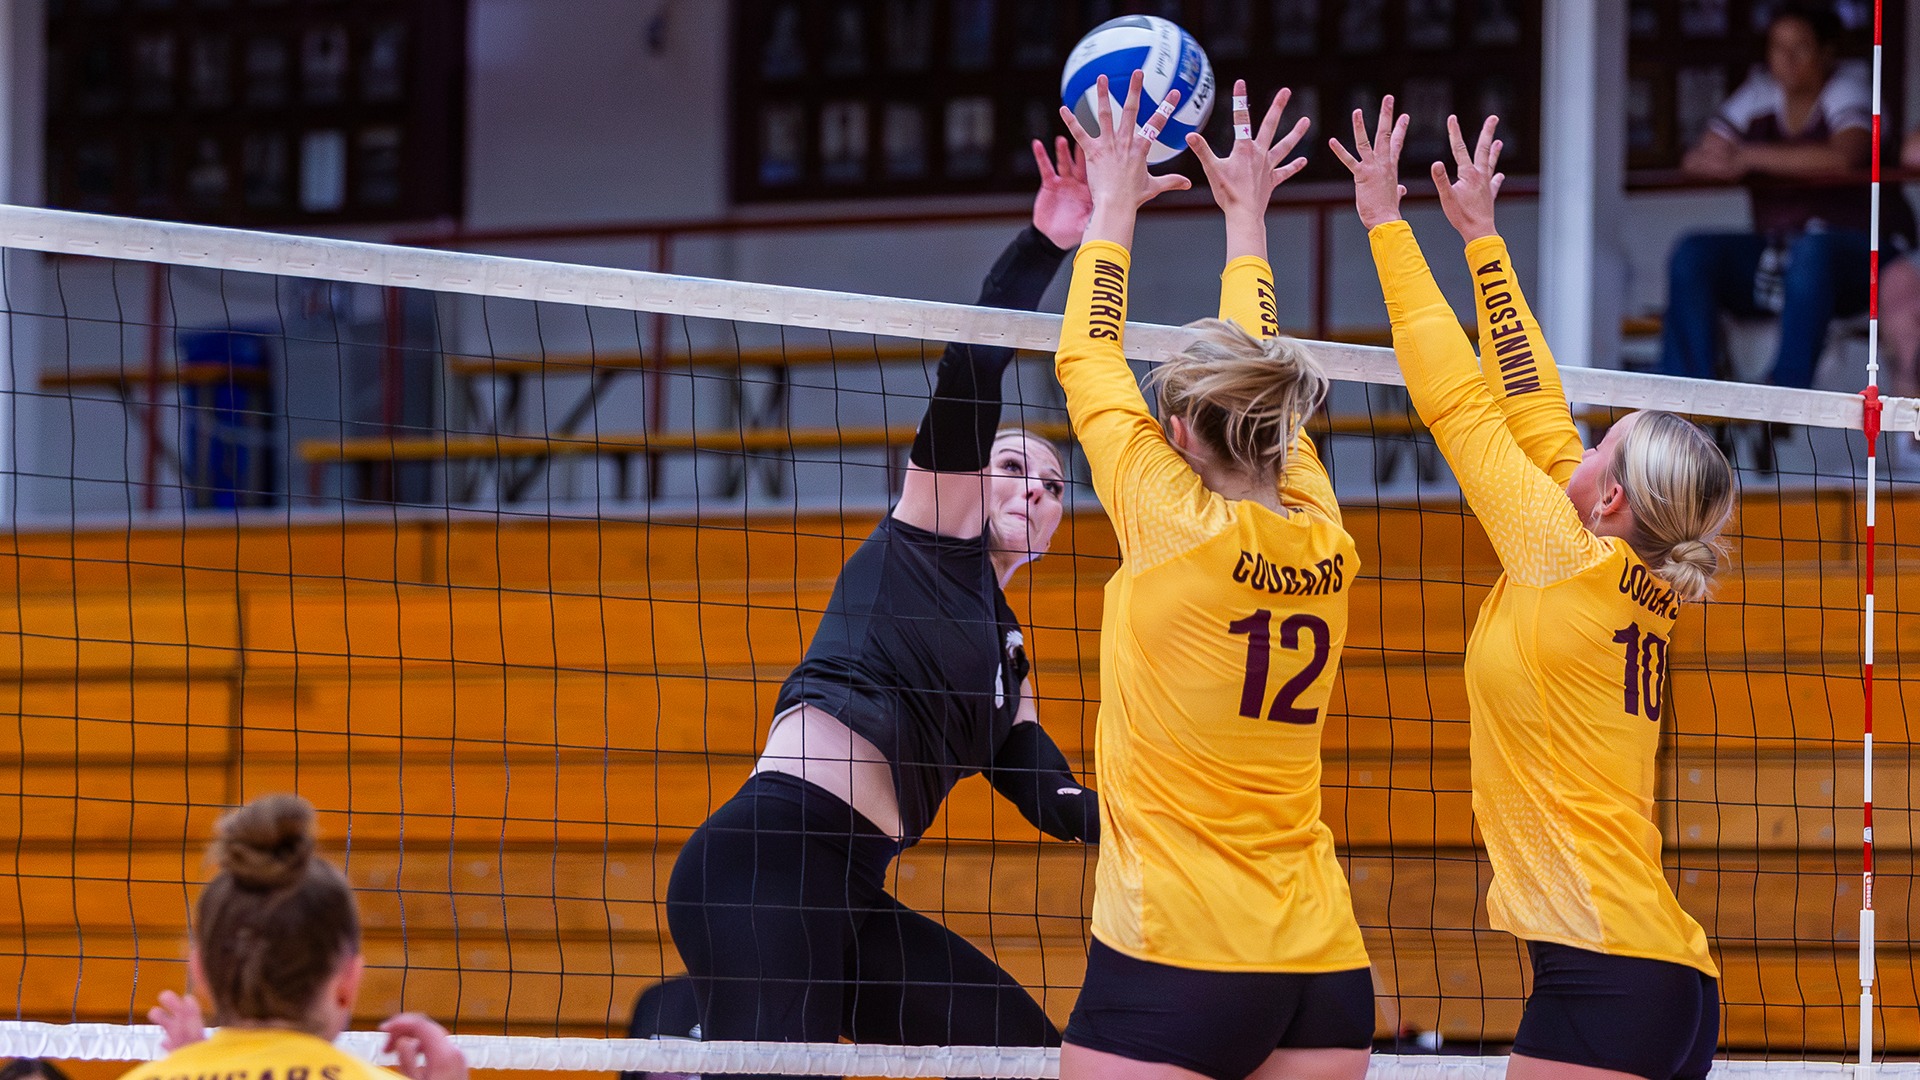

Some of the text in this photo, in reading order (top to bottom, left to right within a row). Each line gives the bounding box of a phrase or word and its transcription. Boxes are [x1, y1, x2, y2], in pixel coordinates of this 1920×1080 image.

[1088, 258, 1125, 342] MORRIS
[1256, 277, 1280, 342] ESOTA
[1476, 258, 1543, 398] MINNESOTA
[1231, 548, 1345, 597] COUGARS
[1227, 608, 1331, 725] 12
[1611, 620, 1668, 722] 10
